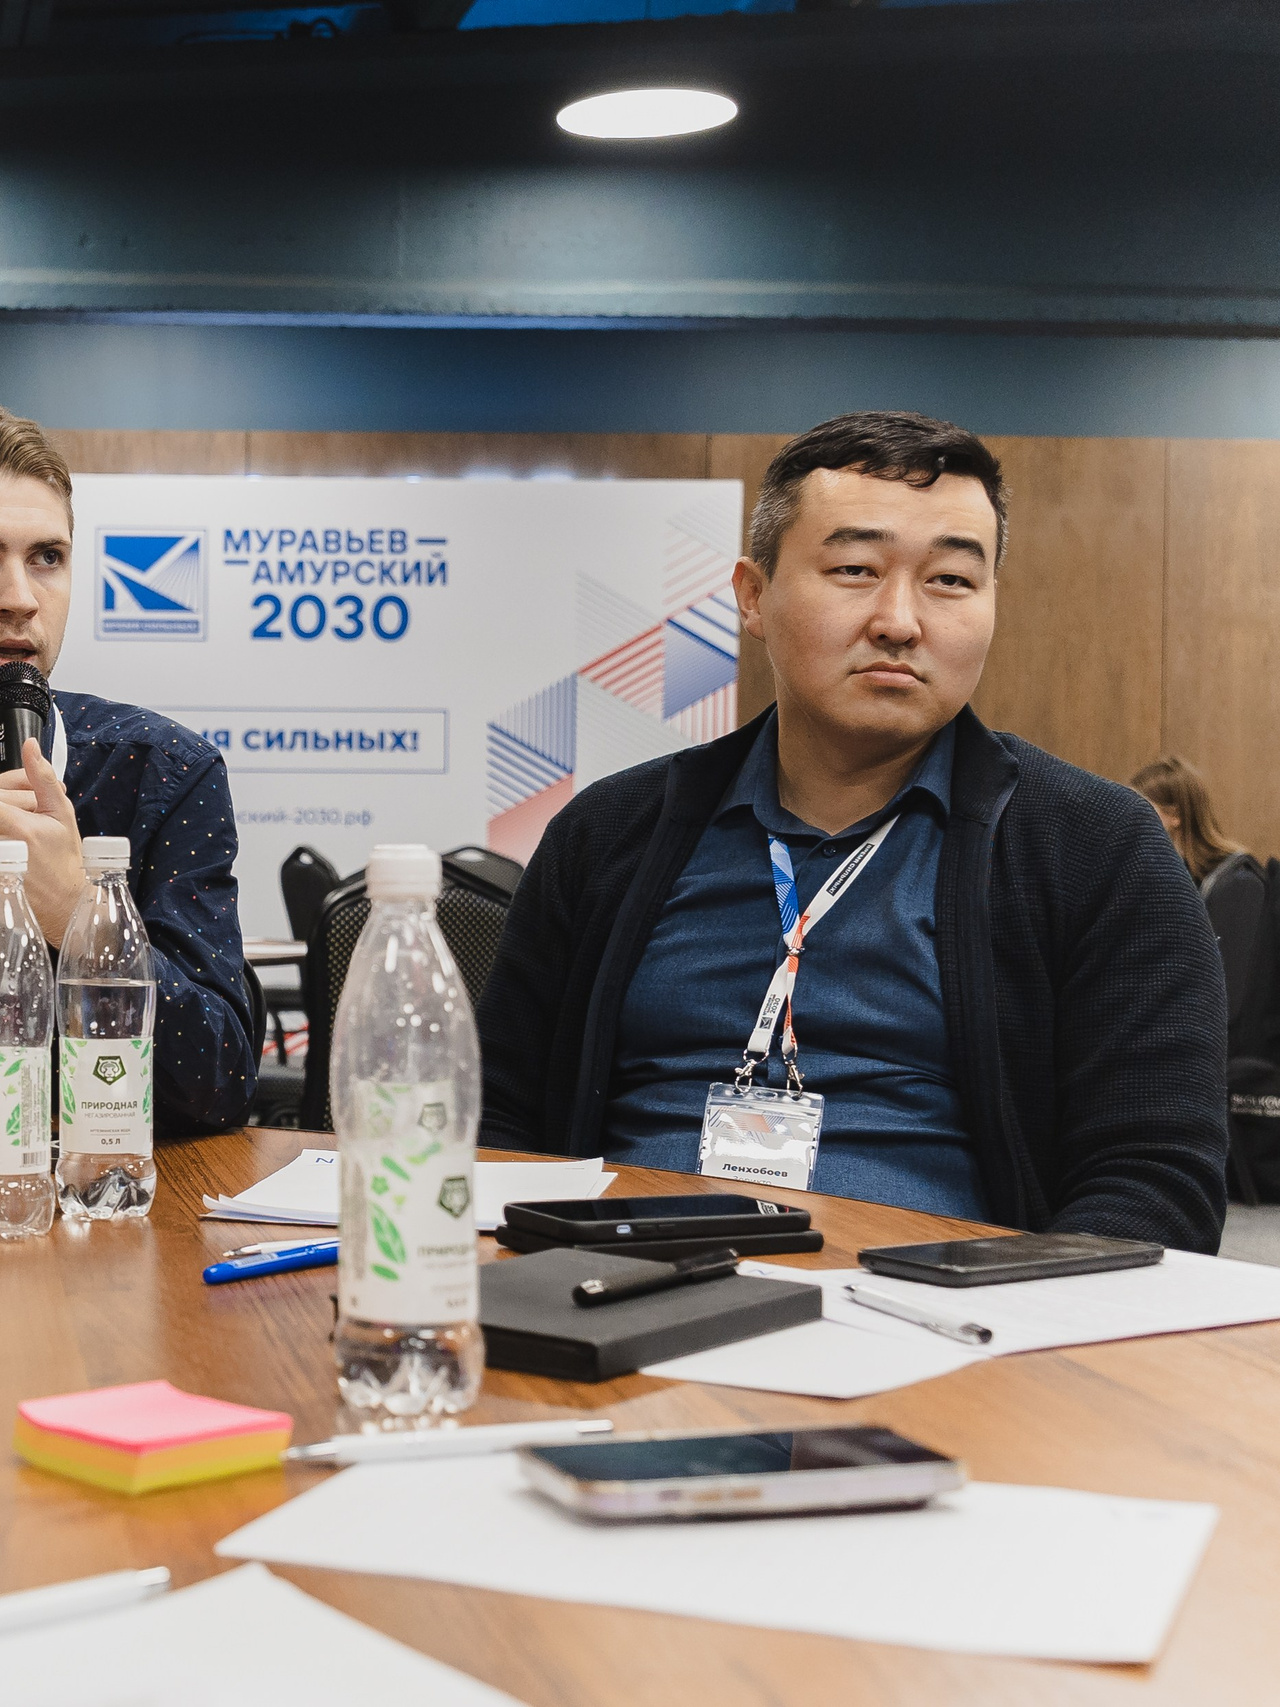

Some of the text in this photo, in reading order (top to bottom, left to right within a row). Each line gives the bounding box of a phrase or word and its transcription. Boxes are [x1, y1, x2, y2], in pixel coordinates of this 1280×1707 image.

[251, 594, 410, 640] 2030
[243, 730, 419, 751] СИЛЬНЫХ!
[81, 1100, 138, 1111] ПРИРОДНАЯ
[100, 1138, 114, 1146] 0,5
[722, 1163, 788, 1178] Ленхобоев
